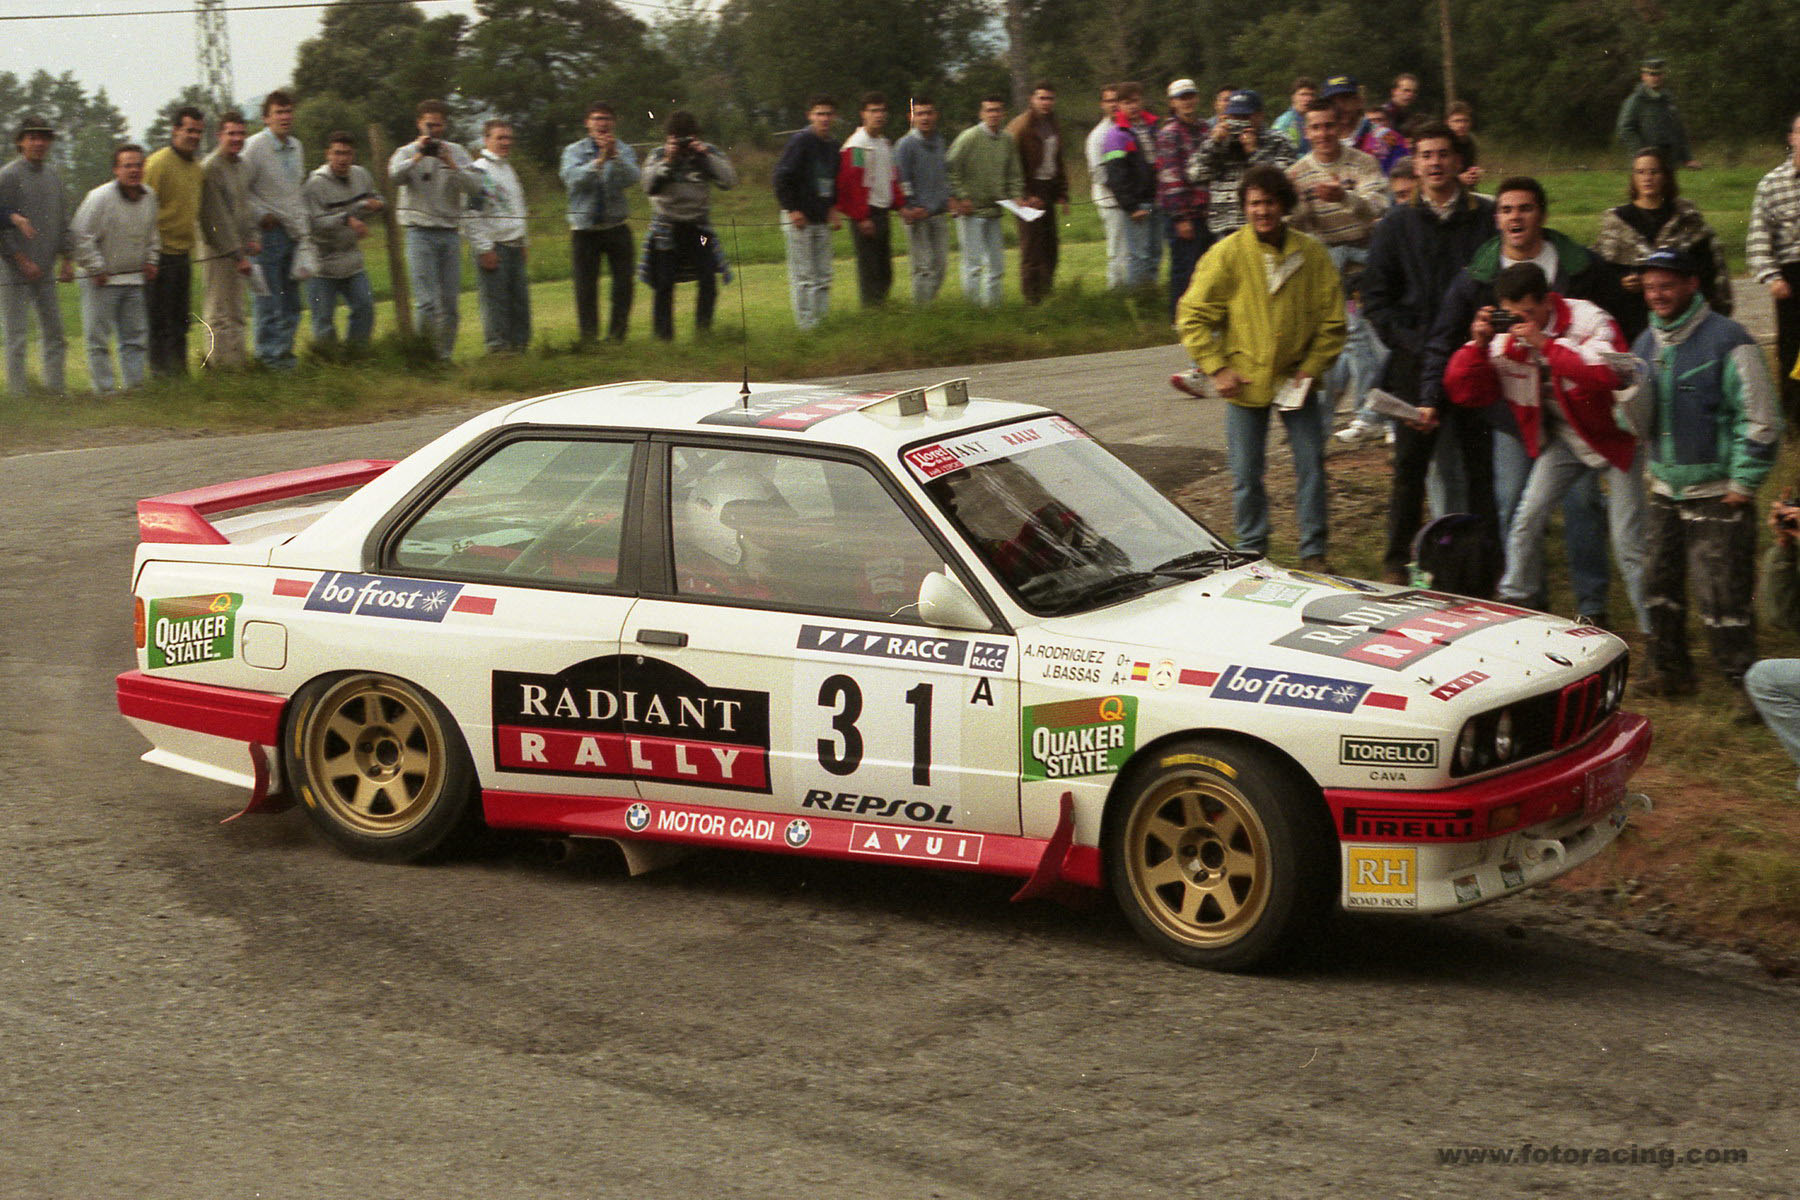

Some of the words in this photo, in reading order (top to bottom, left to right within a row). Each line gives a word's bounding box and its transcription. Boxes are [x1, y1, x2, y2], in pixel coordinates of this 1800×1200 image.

[1001, 428, 1042, 446] RALLY
[155, 615, 227, 650] QUAKER
[165, 639, 214, 665] STATE
[886, 637, 949, 660] RACC
[971, 656, 1003, 670] RACC
[970, 676, 994, 707] A
[1111, 671, 1127, 685] A+
[1440, 673, 1484, 698] AVUI
[520, 684, 741, 732] RADIANT
[817, 674, 934, 787] 31
[1032, 724, 1125, 761] QUAKER
[520, 732, 740, 779] RALLY
[1047, 749, 1109, 777] STATE
[1348, 742, 1430, 762] TORELLÓ
[1369, 771, 1408, 782] CAVA
[801, 789, 954, 824] REPSOL
[658, 810, 725, 836] MOTOR
[729, 816, 775, 841] CADI
[1343, 807, 1475, 838] PIRELLI
[863, 831, 967, 858] AVUI
[1356, 858, 1409, 886] RH
